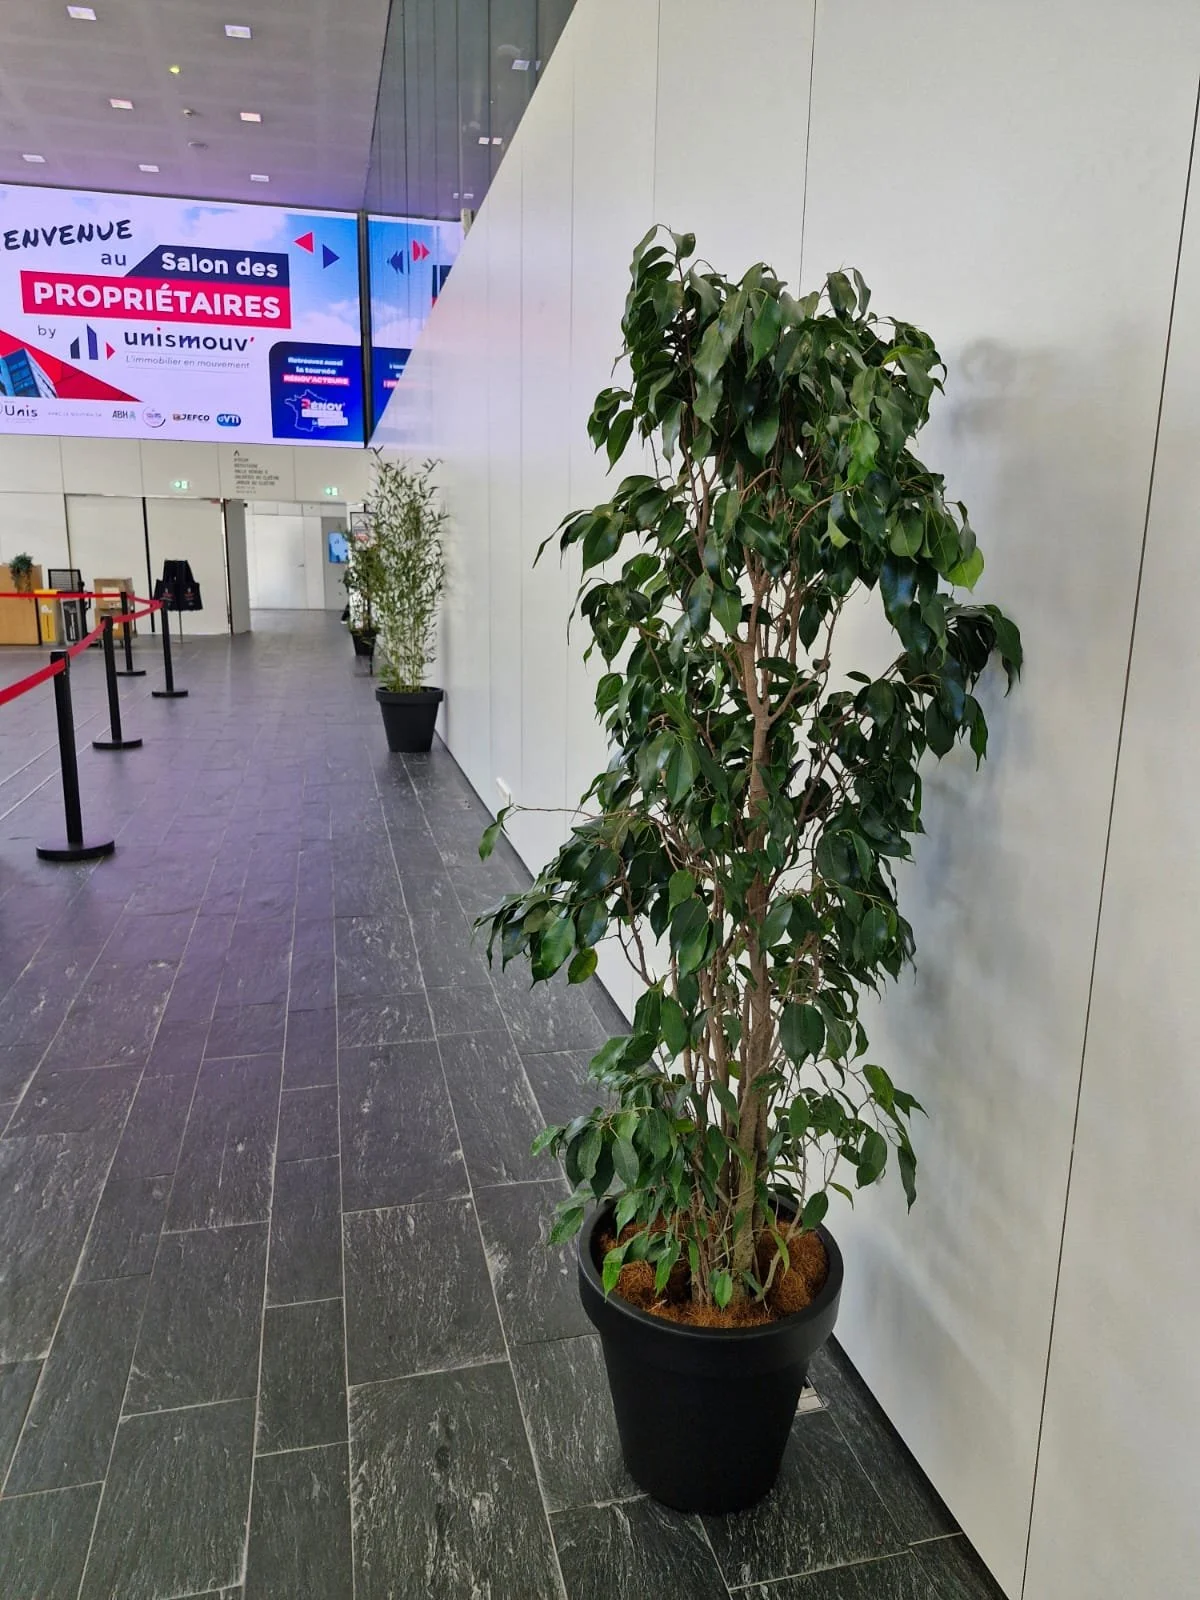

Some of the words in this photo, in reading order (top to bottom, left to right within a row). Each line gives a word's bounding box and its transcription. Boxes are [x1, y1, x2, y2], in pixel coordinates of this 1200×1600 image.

[0, 219, 133, 251] ENVENUE
[101, 252, 127, 267] au
[162, 252, 228, 275] Salon
[236, 257, 279, 279] des
[34, 281, 281, 320] PROPRIÉTAIRES
[38, 324, 56, 338] by
[124, 327, 255, 352] unismouv'
[126, 355, 181, 366] L'immobilier
[183, 359, 195, 367] en
[197, 359, 250, 370] mouvement
[4, 404, 38, 418] Unis
